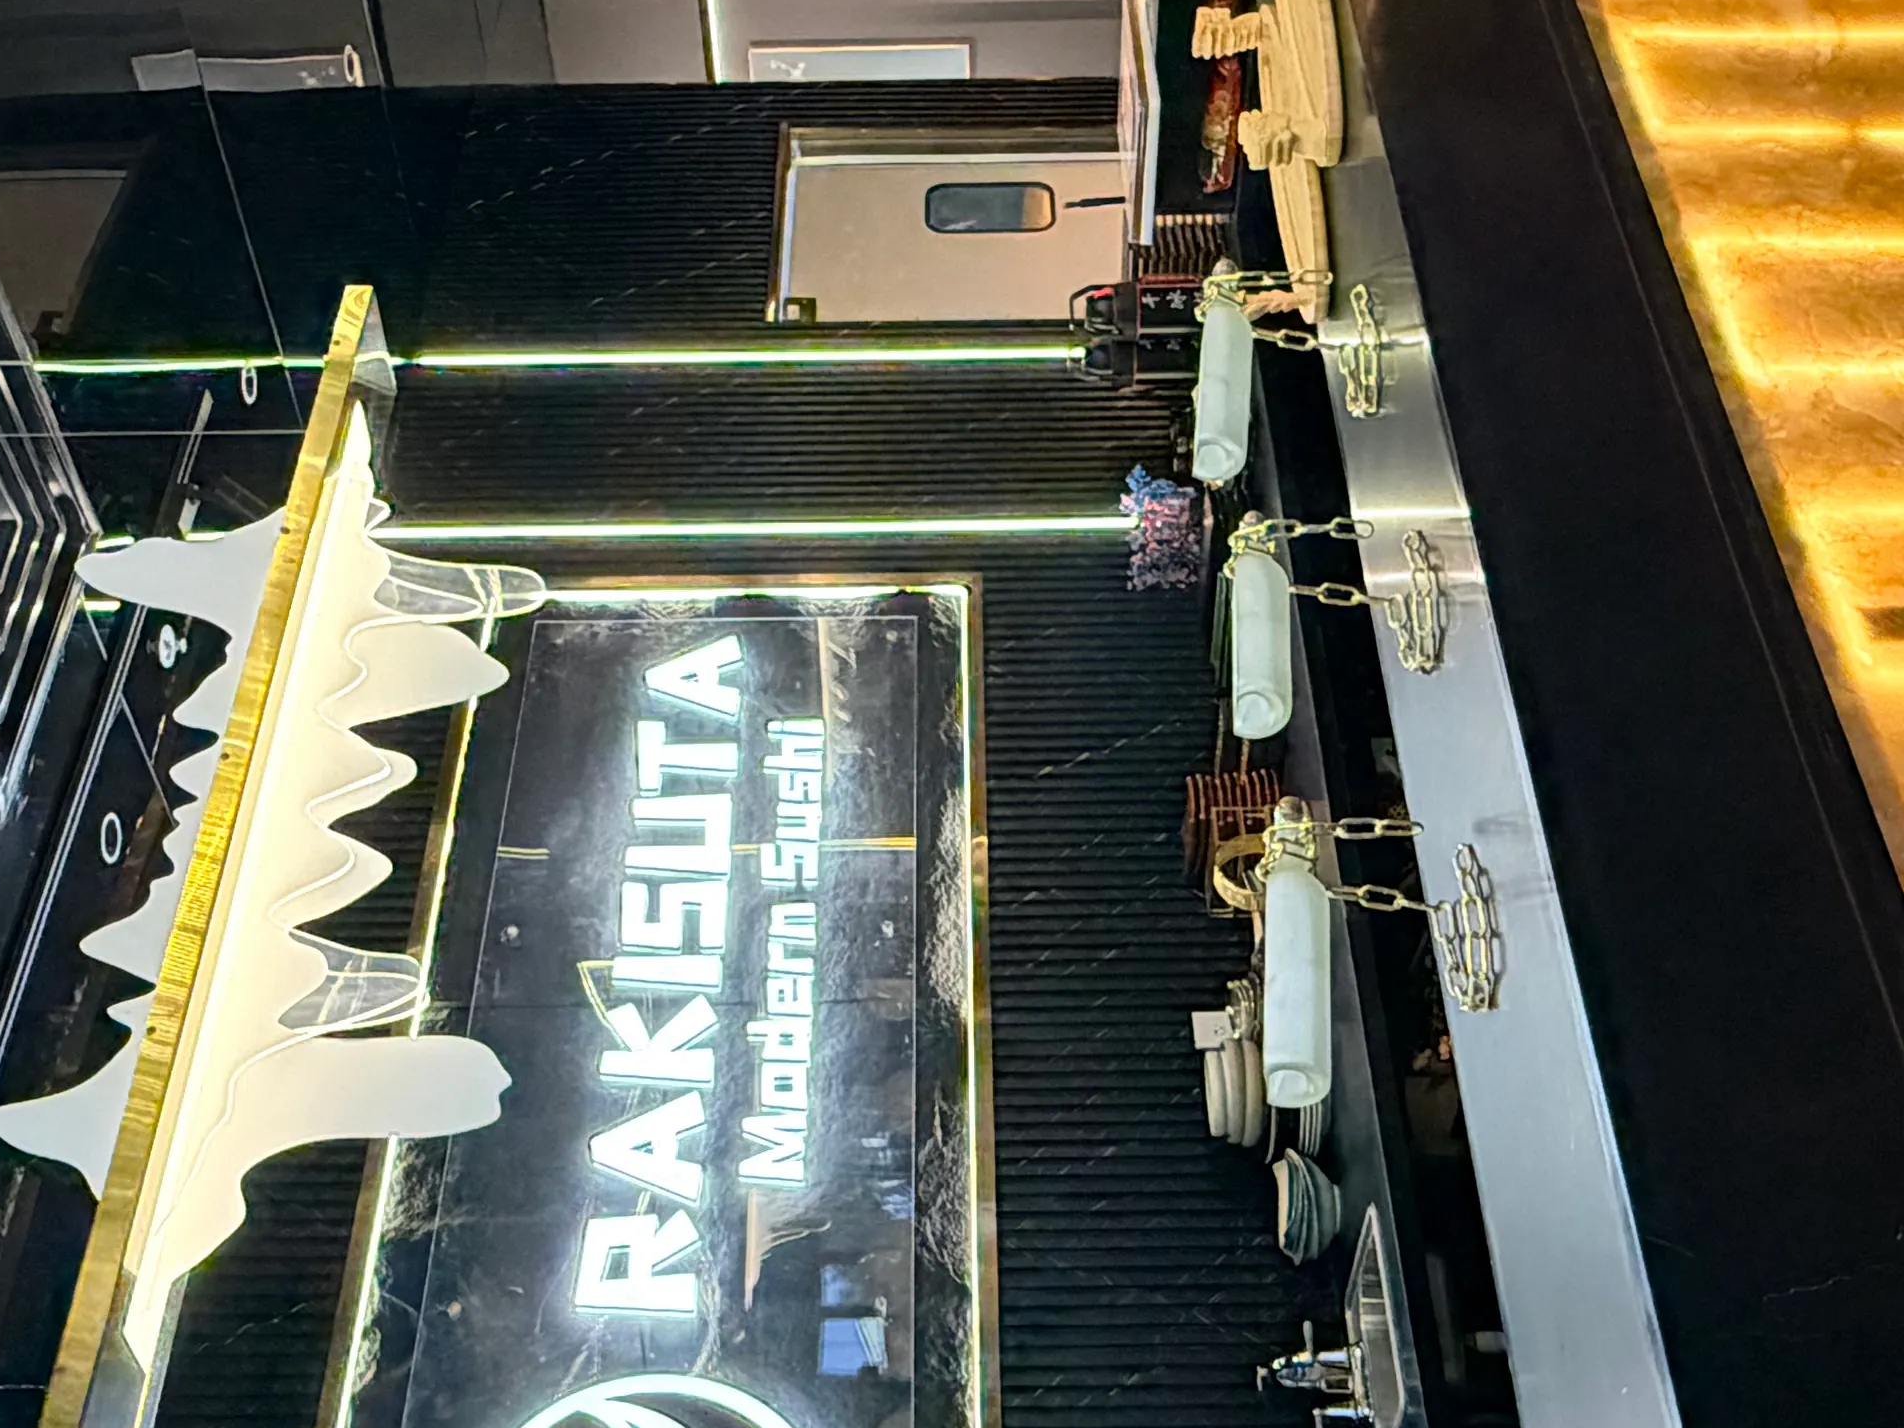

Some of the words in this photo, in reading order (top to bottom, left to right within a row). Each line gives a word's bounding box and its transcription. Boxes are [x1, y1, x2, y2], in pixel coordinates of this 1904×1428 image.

[758, 715, 826, 888] Sushi
[570, 632, 744, 1317] RAKISUTA
[736, 900, 819, 1187] Modern
